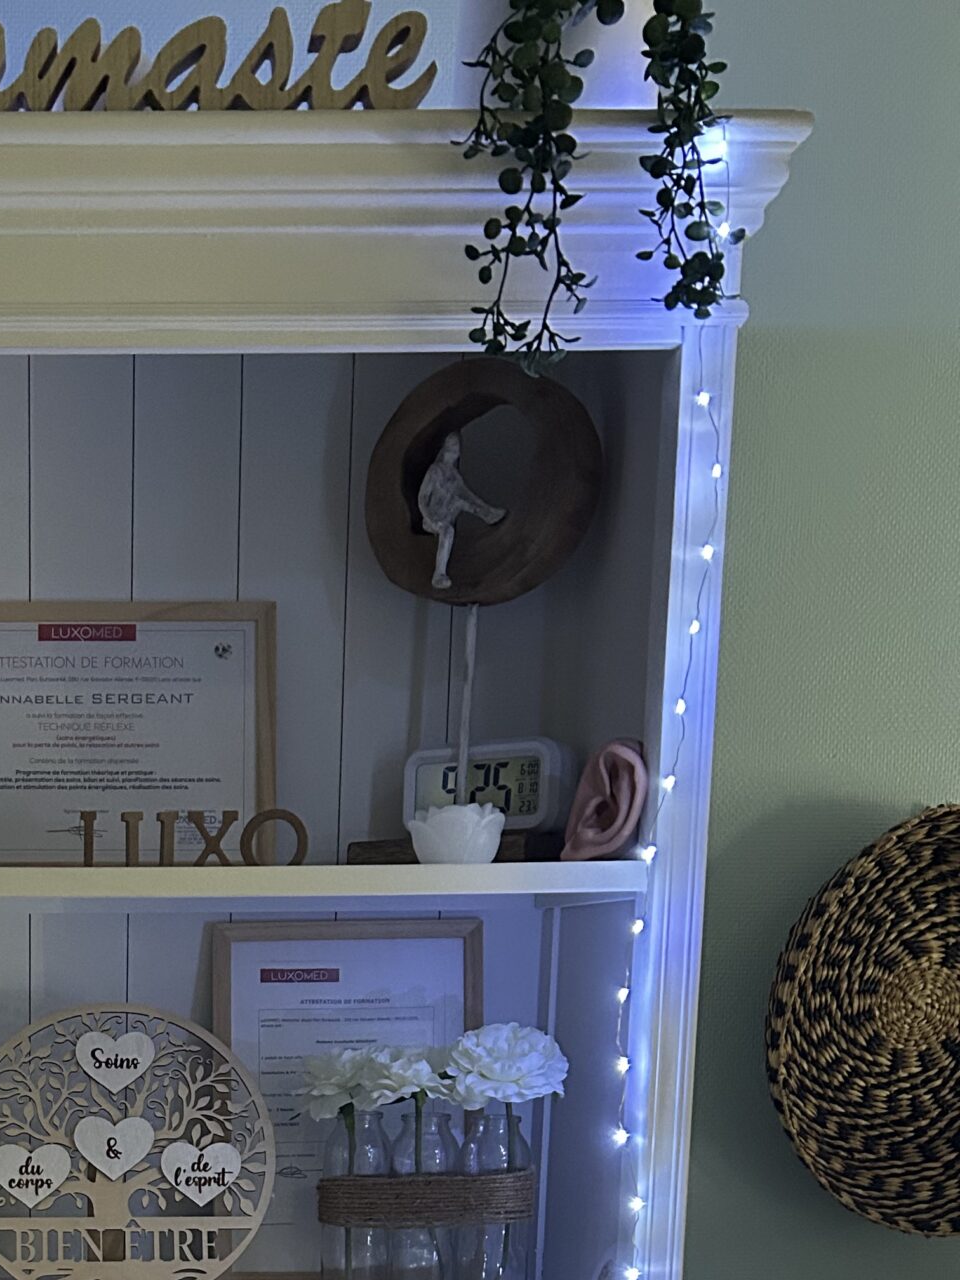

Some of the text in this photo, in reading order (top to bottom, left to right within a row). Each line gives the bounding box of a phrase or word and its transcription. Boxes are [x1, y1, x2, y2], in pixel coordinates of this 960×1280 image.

[51, 626, 122, 642] LUXOMED
[81, 656, 98, 669] DE
[104, 656, 184, 669] FORMATION
[91, 693, 195, 705] SERGEANT
[38, 722, 91, 732] TECHNIQUE
[270, 970, 329, 983] LUXOMED
[89, 1047, 140, 1071] Soins
[105, 1137, 123, 1160] &
[18, 1156, 44, 1176] du
[189, 1153, 212, 1173] de
[7, 1174, 54, 1197] corps
[173, 1169, 234, 1195] l'esprit
[16, 1219, 220, 1263] BIEN ÊTRE
